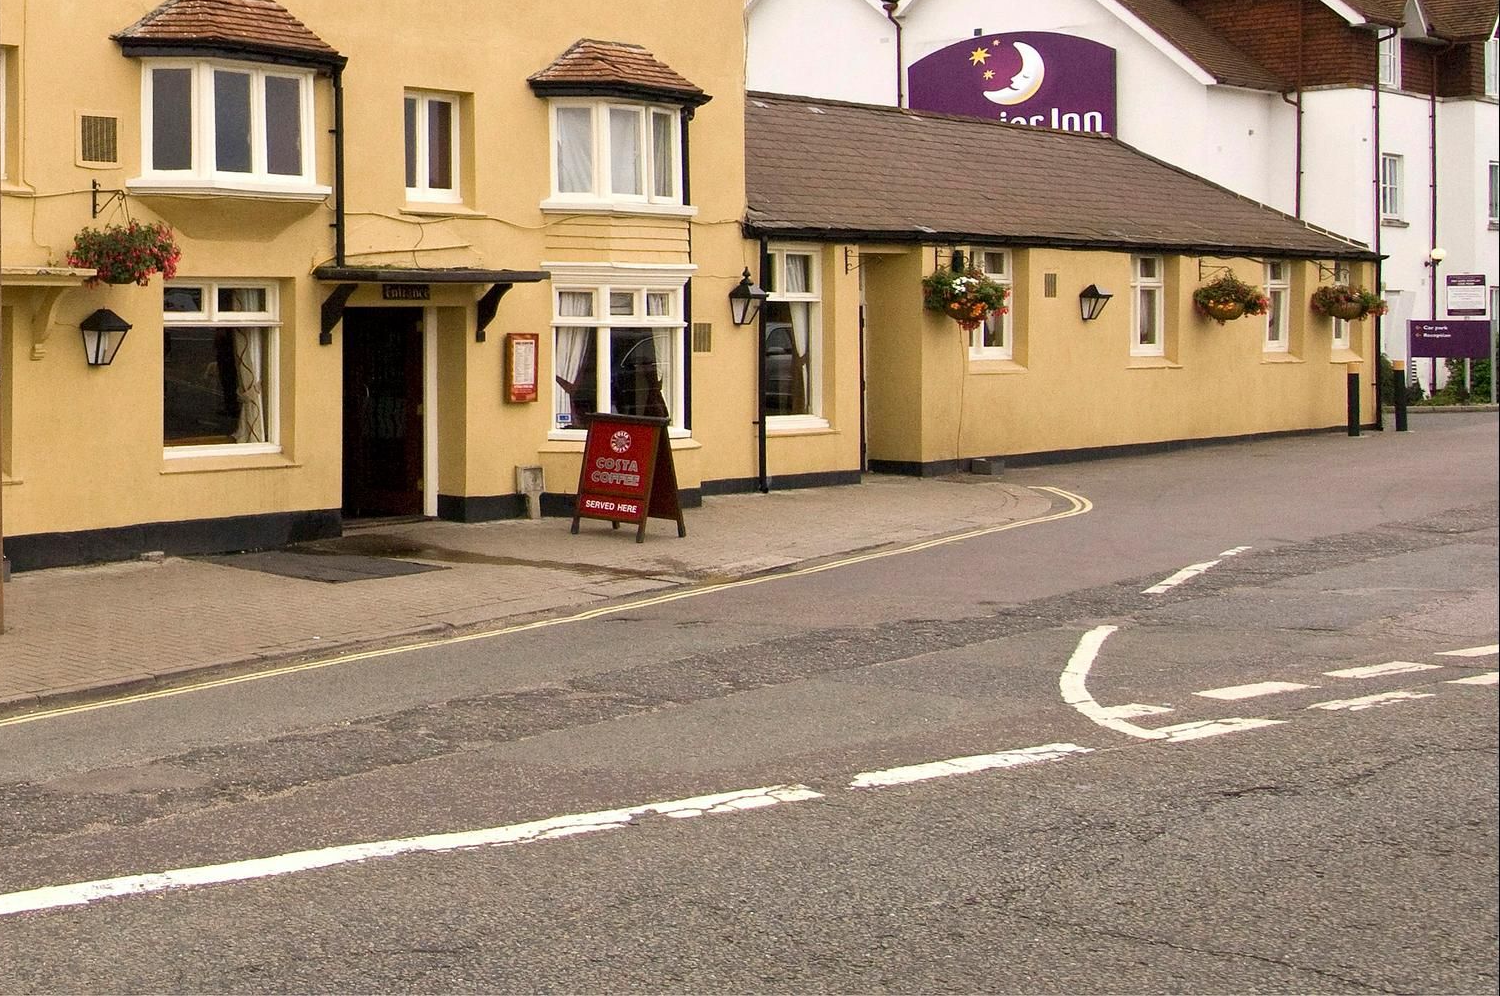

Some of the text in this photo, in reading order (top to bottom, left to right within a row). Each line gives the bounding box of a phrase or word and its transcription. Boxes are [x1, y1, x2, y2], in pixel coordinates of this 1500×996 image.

[1051, 107, 1103, 133] Inn
[596, 457, 638, 472] COSTA
[591, 471, 640, 486] COFFEE
[585, 500, 637, 513] SERVED HERE
